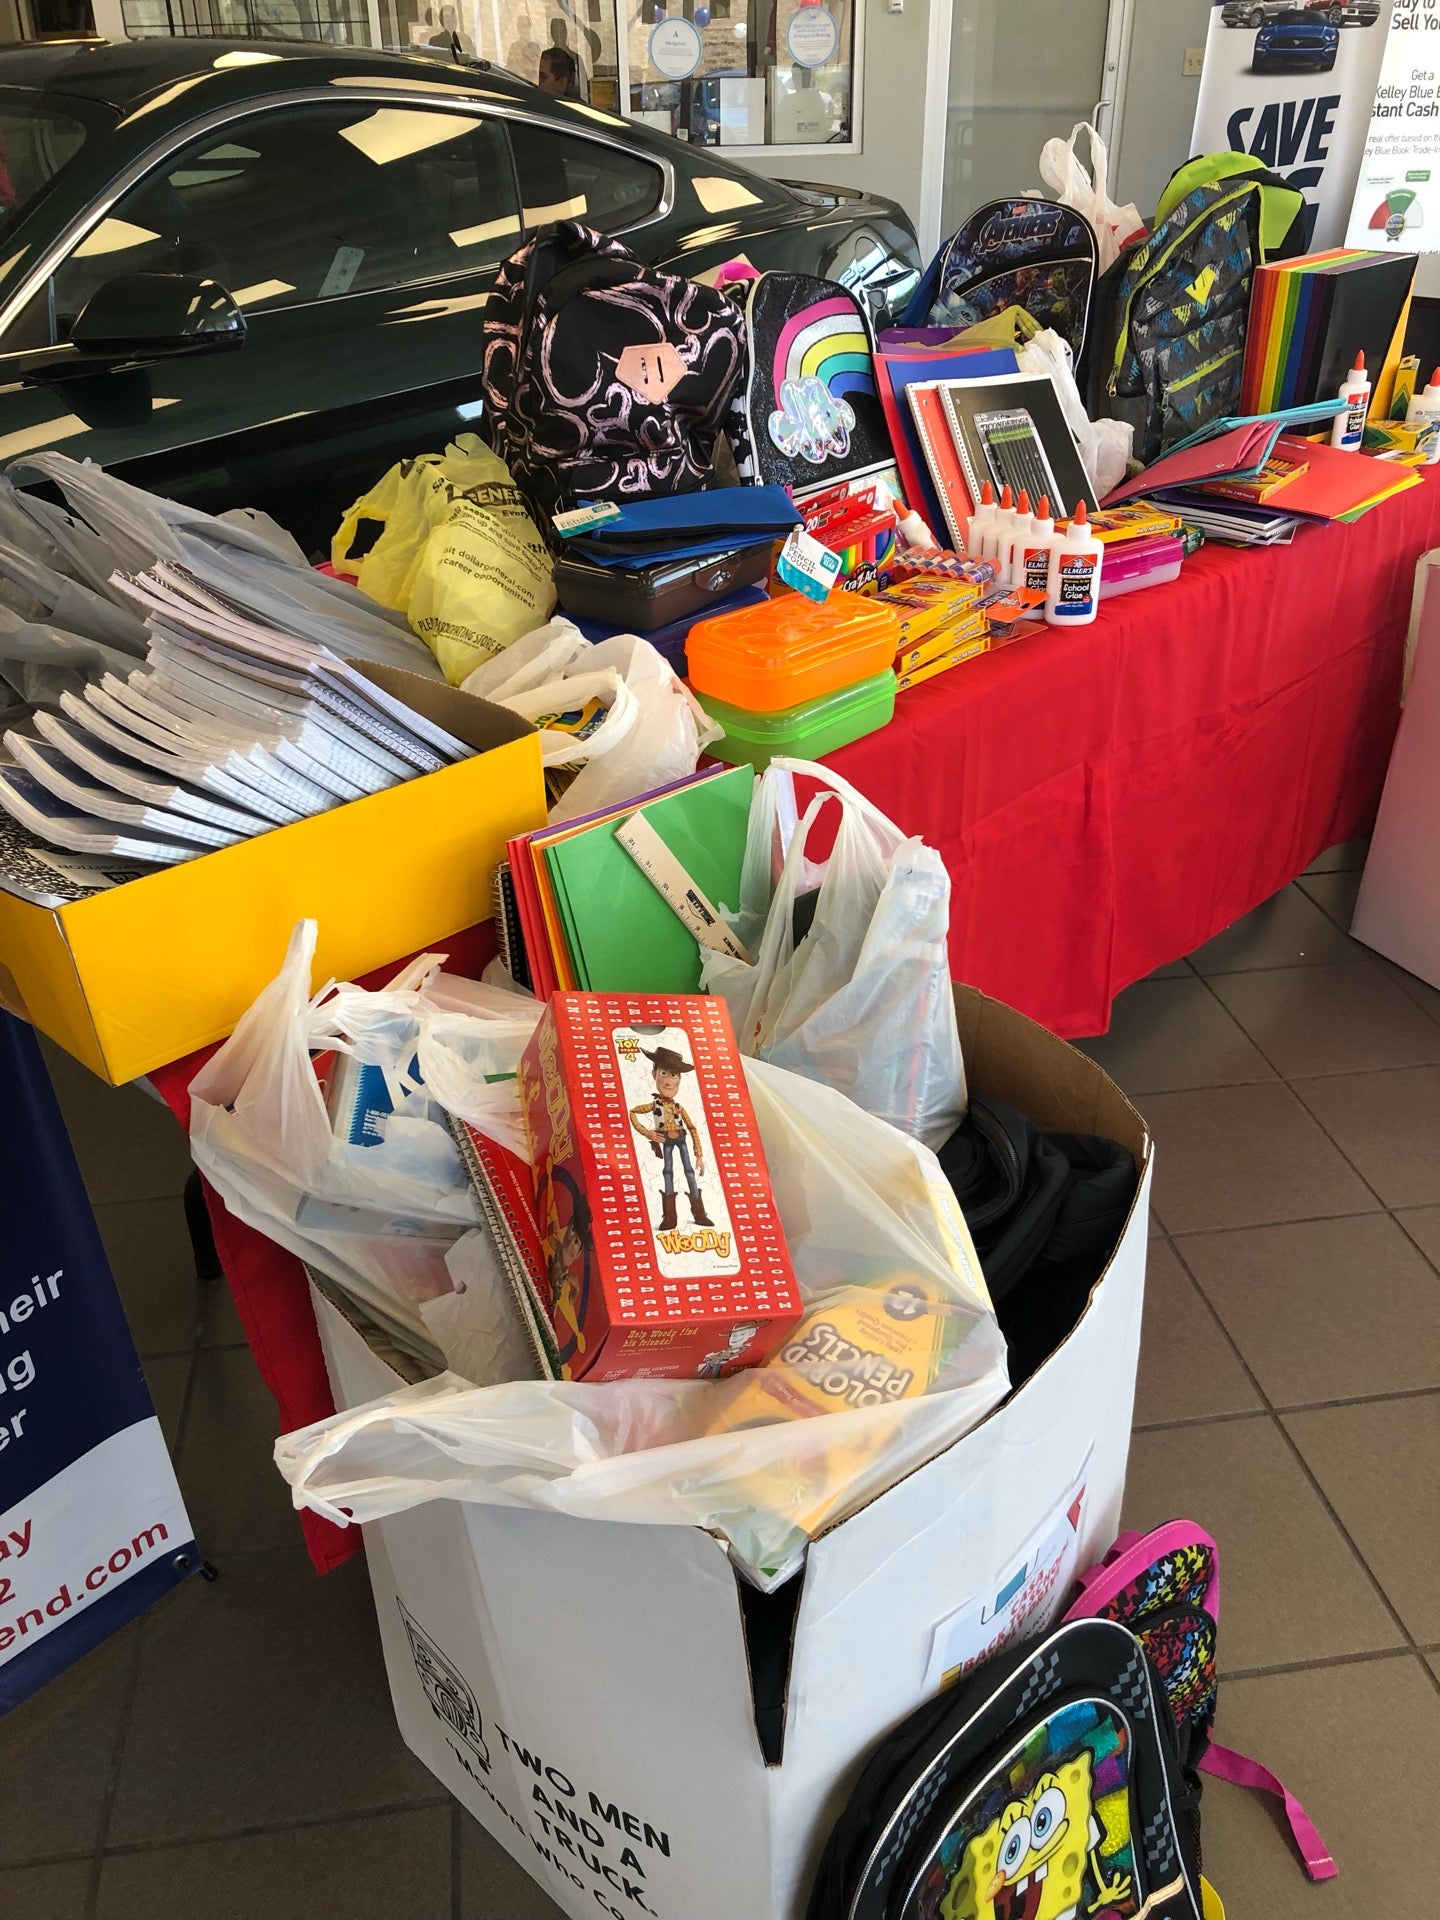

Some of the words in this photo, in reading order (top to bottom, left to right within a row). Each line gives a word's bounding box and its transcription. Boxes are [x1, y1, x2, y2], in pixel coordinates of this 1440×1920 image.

[1392, 13, 1419, 30] Sell
[1424, 13, 1440, 30] Yo
[1411, 69, 1427, 81] Get
[1428, 72, 1435, 81] a
[1409, 85, 1434, 99] Blue
[1406, 101, 1439, 117] Cash
[1227, 95, 1341, 168] SAVE
[806, 517, 819, 532] 20
[786, 551, 814, 574] POUCH
[788, 546, 816, 570] PENCIL
[1062, 567, 1093, 575] ELMER'S
[1063, 583, 1089, 592] School
[1065, 591, 1083, 599] Glue
[615, 1038, 640, 1049] TOY
[625, 1052, 636, 1062] 4
[628, 1330, 647, 1339] Help
[650, 1329, 676, 1338] Woody
[679, 1327, 699, 1336] find
[623, 1339, 637, 1348] his
[639, 1338, 673, 1347] friends!
[805, 1323, 913, 1396] PENCILS
[494, 1722, 576, 1797] TWO
[588, 1791, 671, 1857] MEN
[532, 1784, 604, 1847] AND
[620, 1847, 646, 1879] A
[531, 1833, 585, 1890] Who
